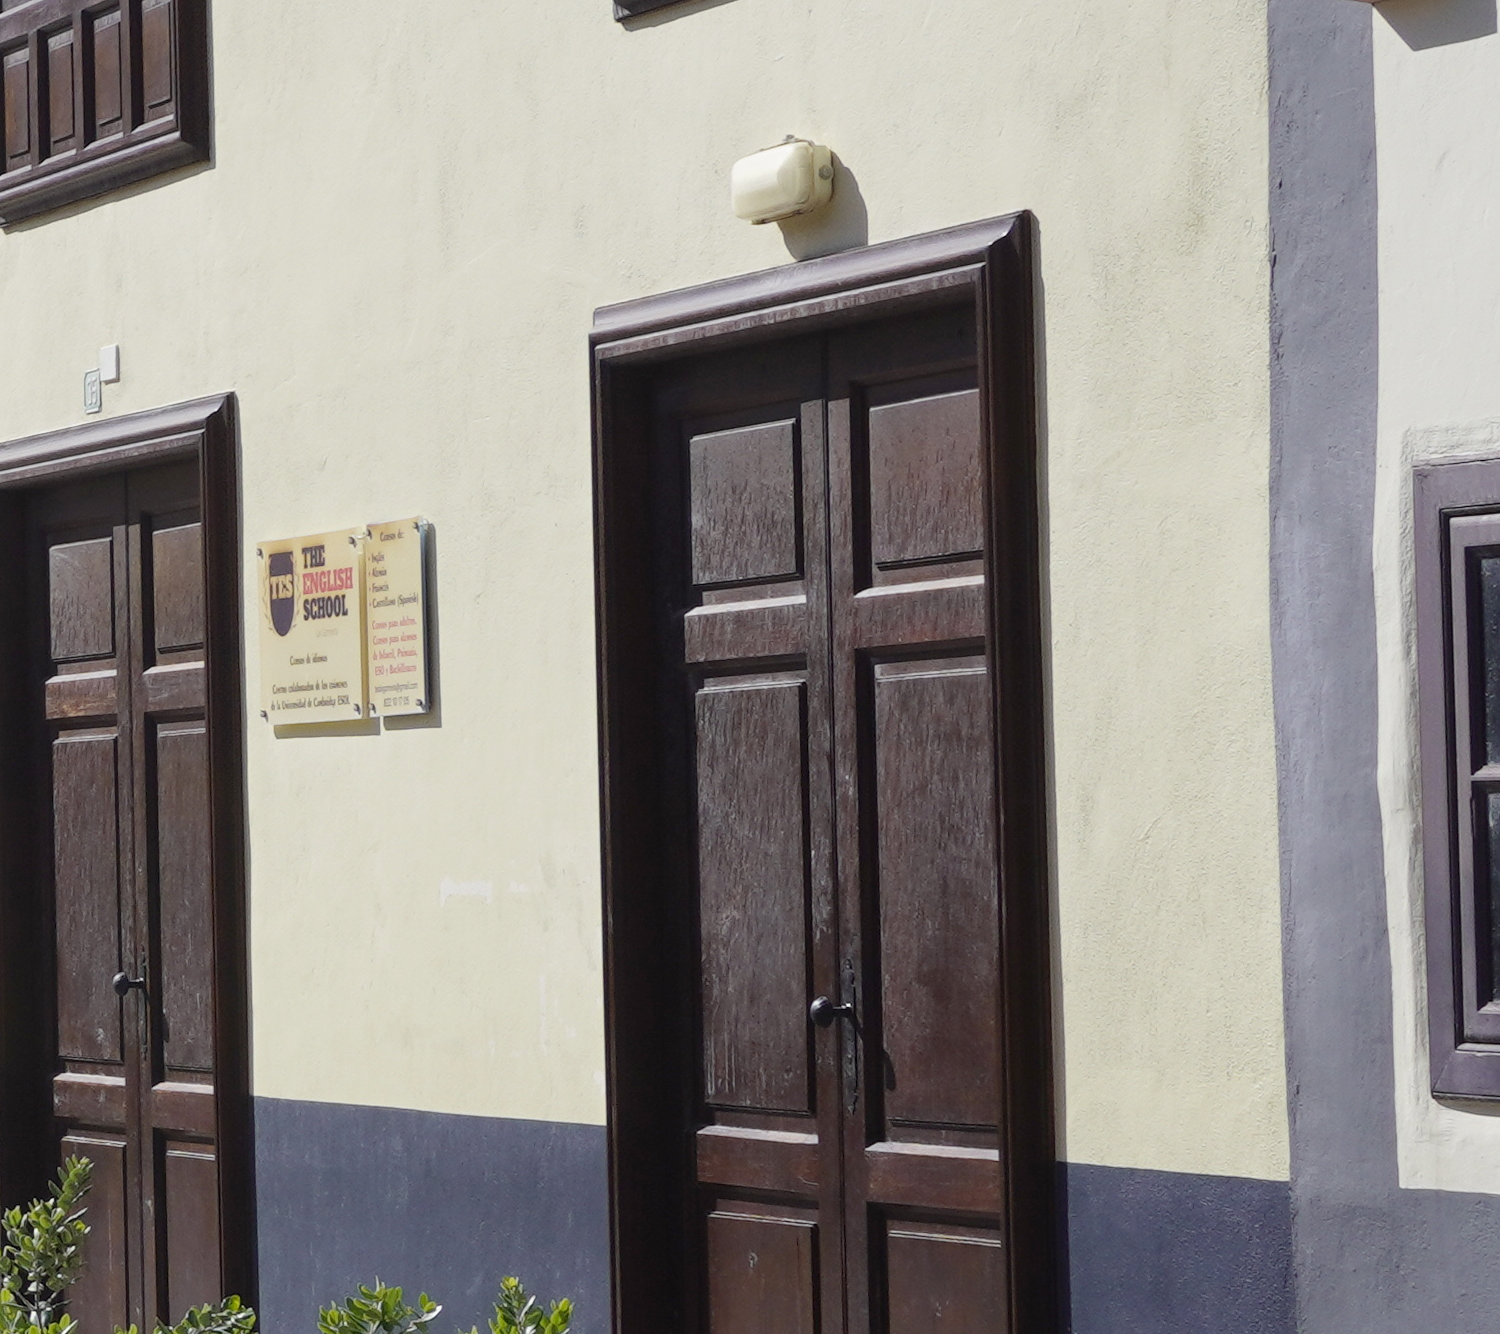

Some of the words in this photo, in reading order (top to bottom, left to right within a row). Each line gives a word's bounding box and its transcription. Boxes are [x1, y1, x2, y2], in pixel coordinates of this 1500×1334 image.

[301, 544, 326, 569] THE
[270, 574, 293, 600] TES
[302, 567, 353, 595] ENGLISH
[303, 594, 349, 621] SCHOOL
